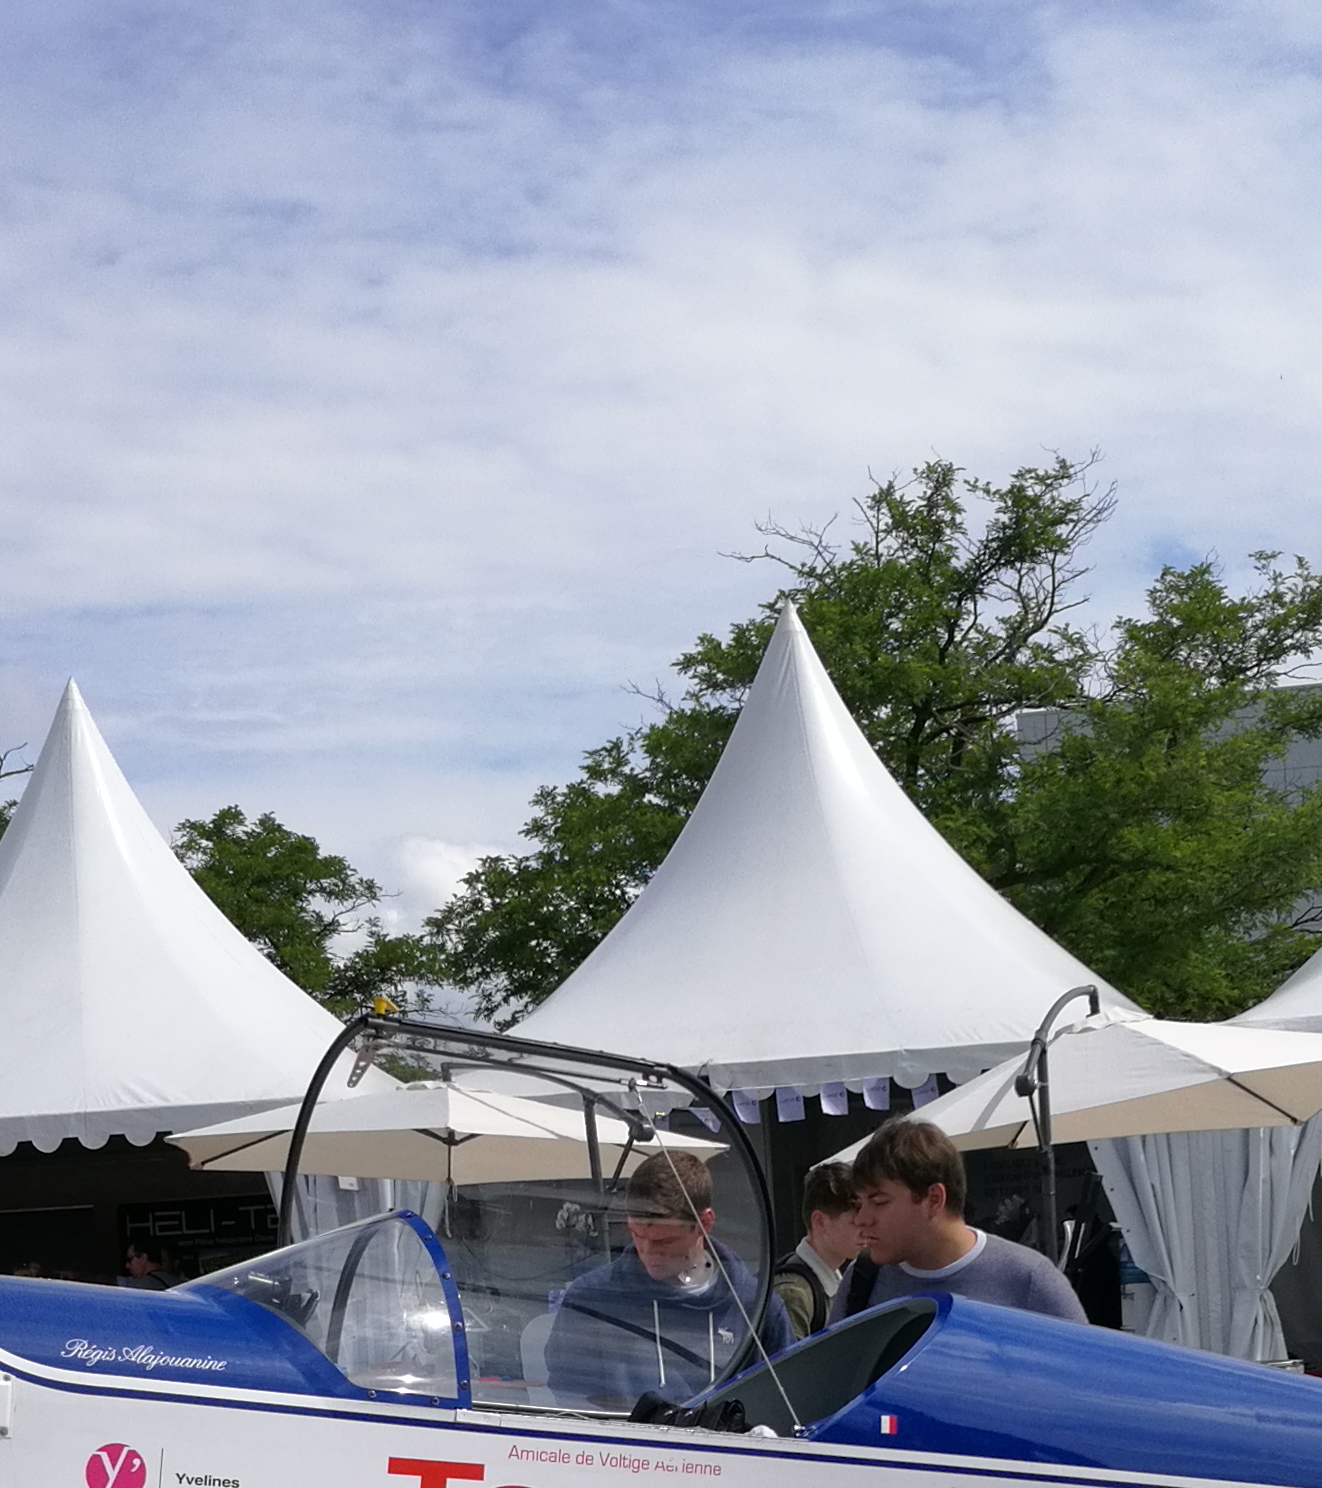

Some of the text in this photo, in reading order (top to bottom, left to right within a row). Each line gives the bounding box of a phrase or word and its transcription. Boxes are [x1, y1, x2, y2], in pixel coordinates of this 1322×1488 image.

[61, 1338, 227, 1371] Régis Alajouanine
[508, 1445, 570, 1464] Amicale
[575, 1451, 594, 1466] de
[599, 1452, 649, 1473] Voltige
[175, 1473, 240, 1488] Yvelines
